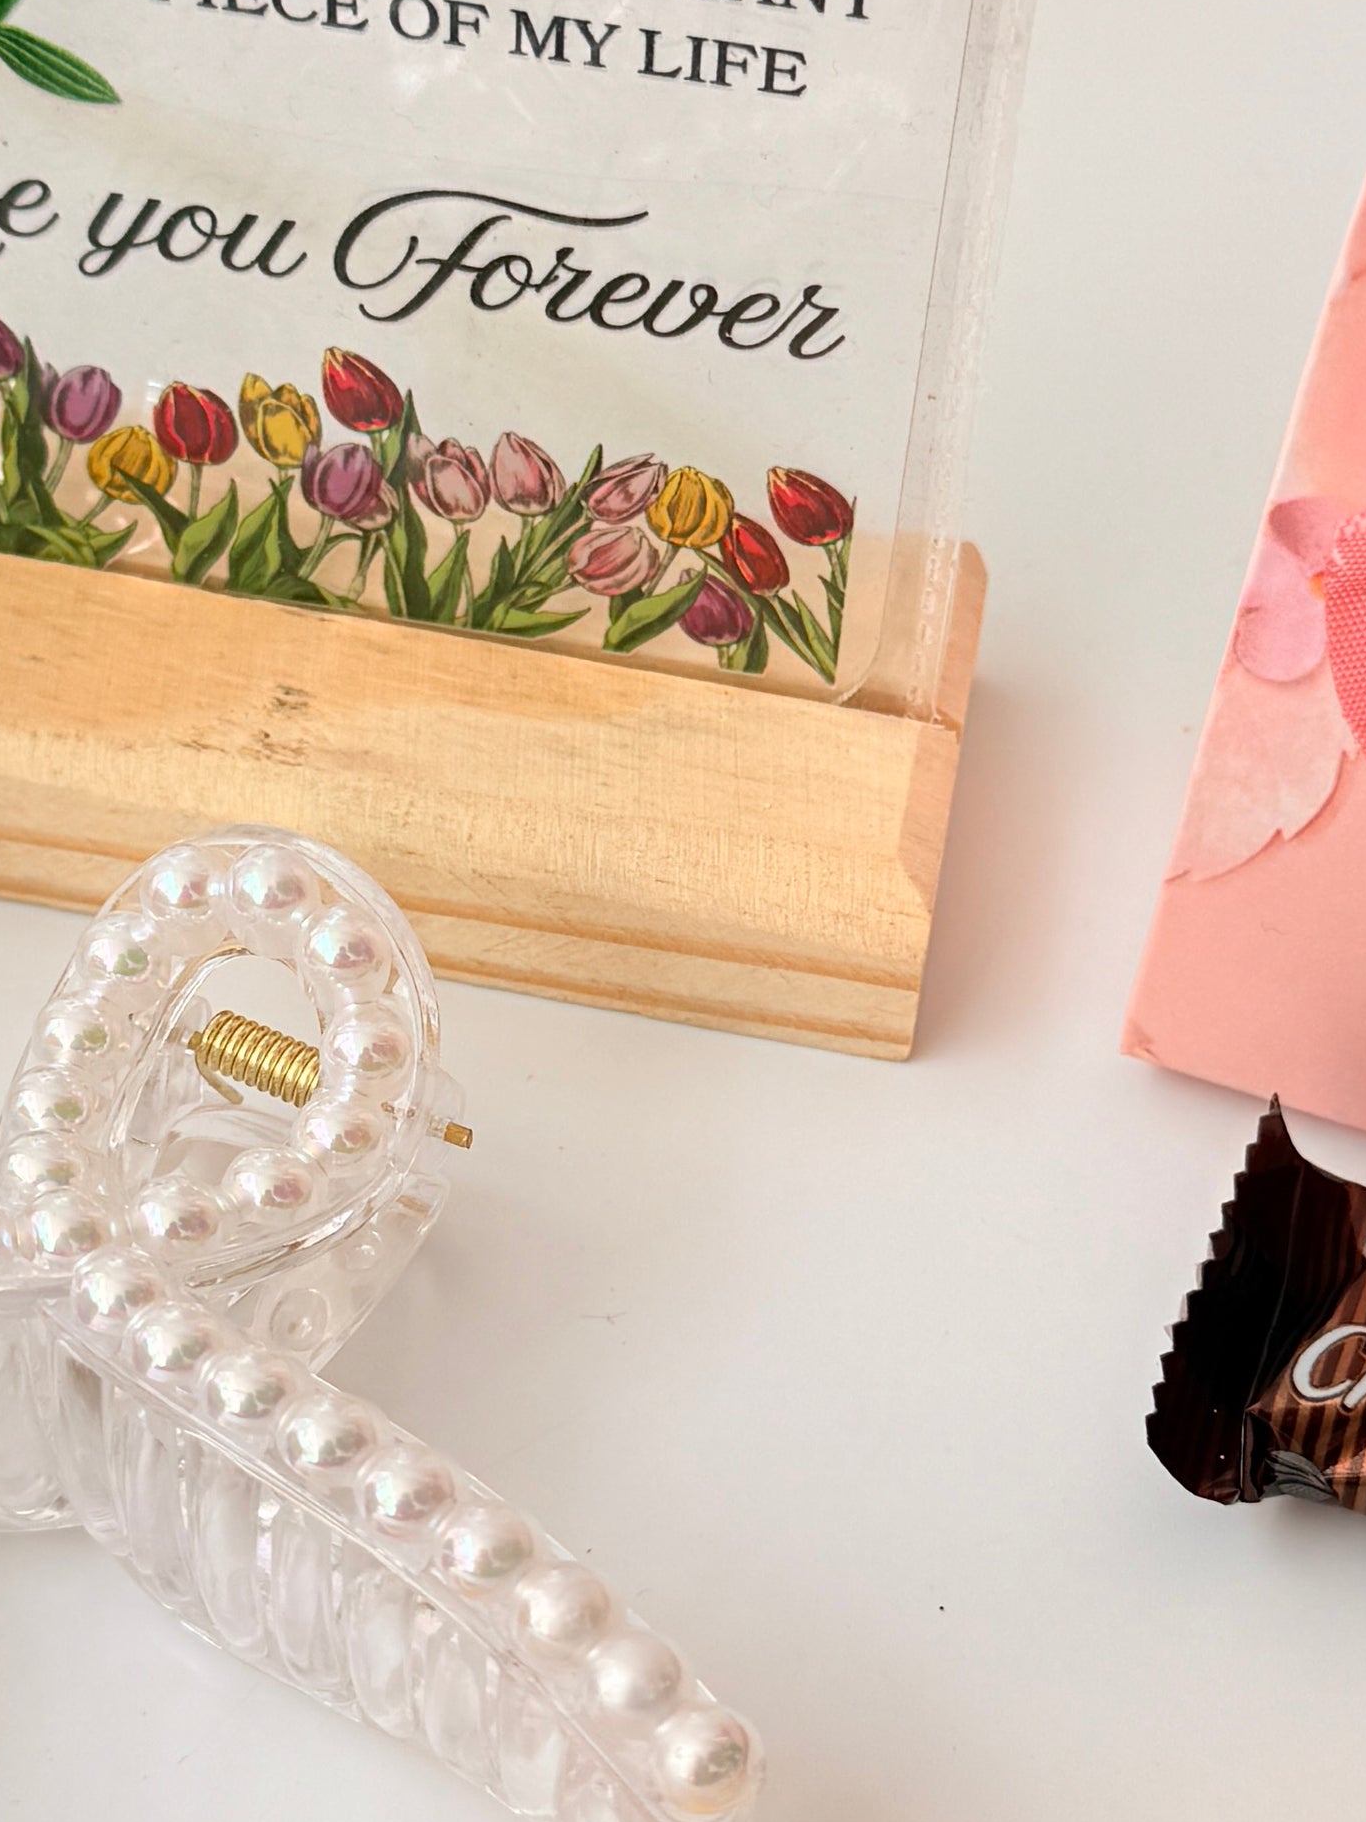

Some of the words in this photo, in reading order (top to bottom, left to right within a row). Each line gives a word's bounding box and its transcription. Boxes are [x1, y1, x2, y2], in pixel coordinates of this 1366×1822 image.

[508, 7, 623, 74] MY
[635, 27, 809, 99] LIFE
[77, 191, 309, 279] you
[332, 188, 847, 361] Forever
